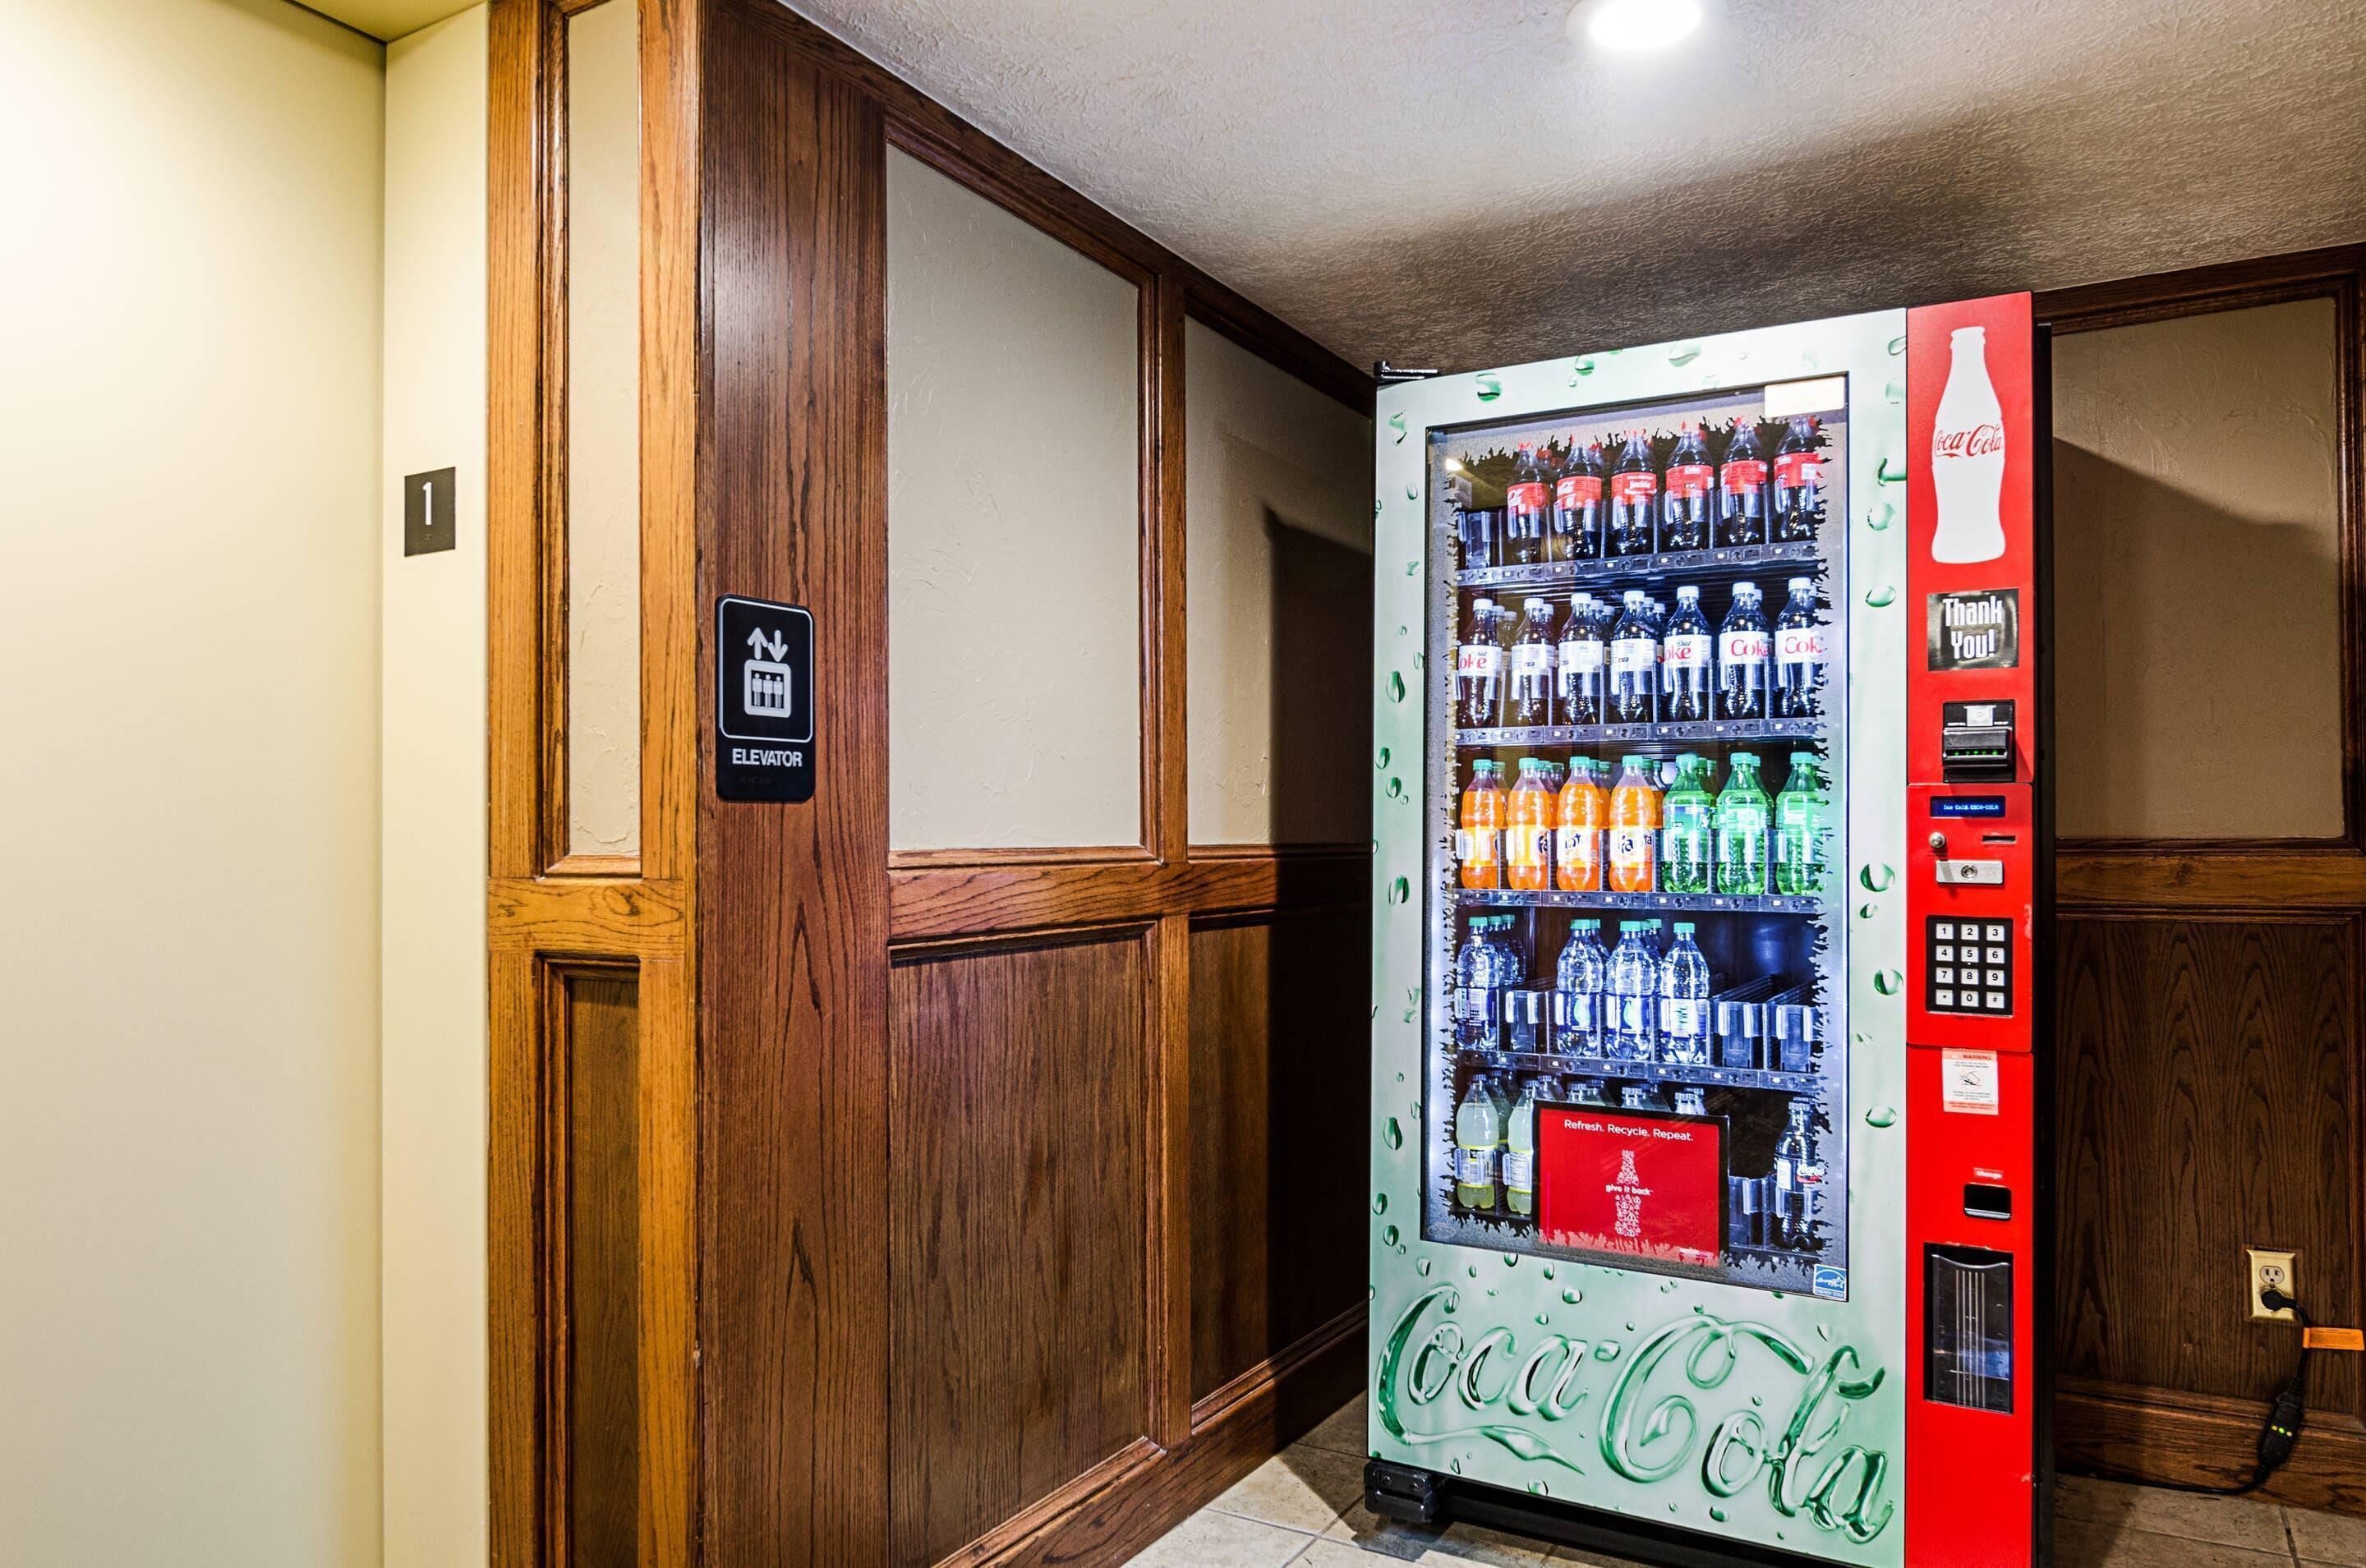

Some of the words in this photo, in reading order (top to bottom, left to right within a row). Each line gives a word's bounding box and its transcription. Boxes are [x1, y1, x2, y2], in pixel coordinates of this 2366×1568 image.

[1935, 424, 2002, 458] Coca-Cola
[421, 481, 433, 526] 1
[1942, 595, 2003, 627] Thank
[1950, 628, 1995, 660] You!
[732, 748, 803, 767] ELEVATOR
[1967, 927, 1973, 936] 2
[1992, 928, 1999, 936] 3
[1966, 950, 1973, 958] 5
[1991, 950, 1999, 959] 6
[1966, 972, 1973, 980] 8
[1992, 973, 1999, 981] 9
[1966, 994, 1973, 1002] 0
[1564, 1119, 1604, 1132] Refresh.
[1608, 1123, 1650, 1138] Recycle.
[1653, 1128, 1694, 1142] Repeat.
[1605, 1184, 1623, 1193] give
[1624, 1185, 1631, 1193] it
[1376, 1282, 1894, 1544] Coca-Cola
